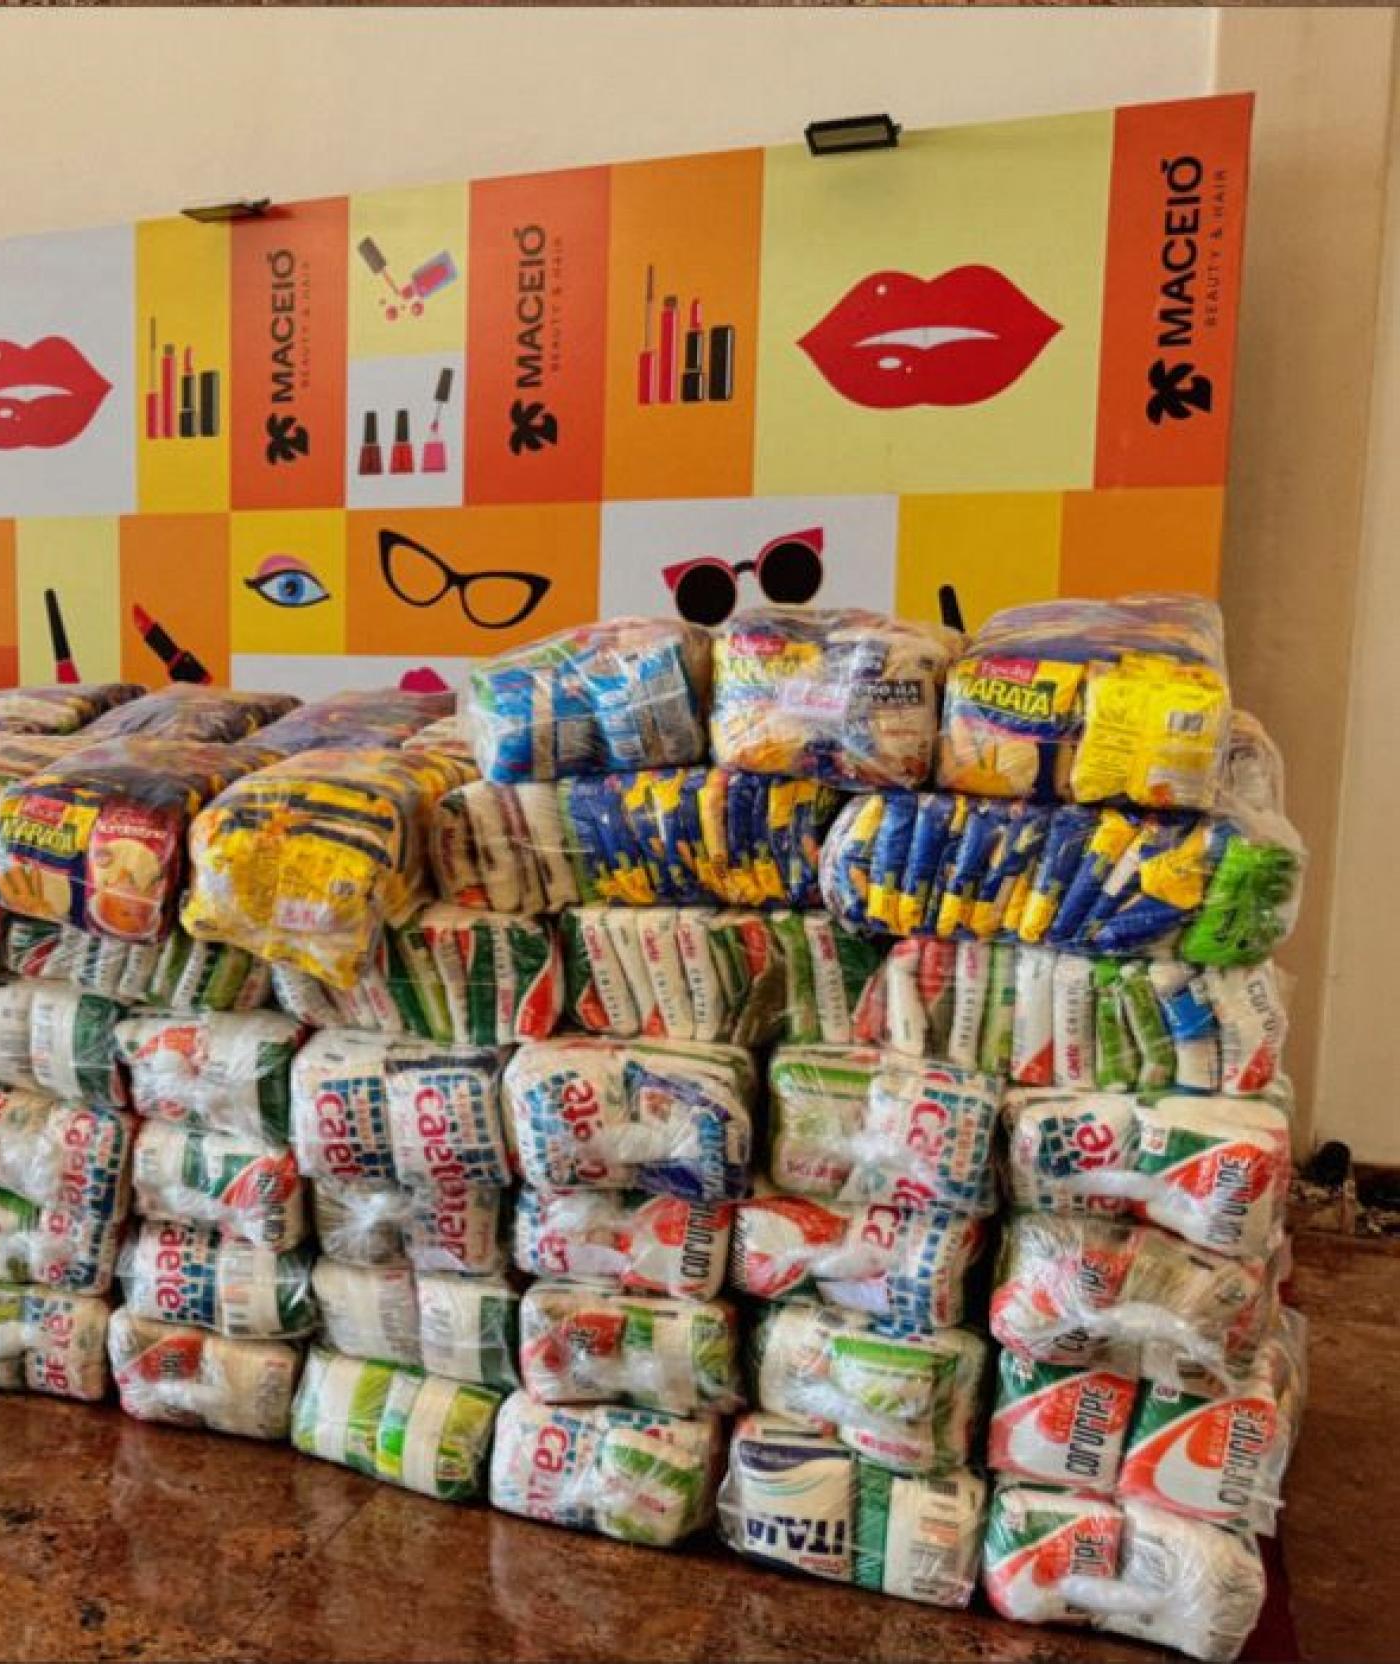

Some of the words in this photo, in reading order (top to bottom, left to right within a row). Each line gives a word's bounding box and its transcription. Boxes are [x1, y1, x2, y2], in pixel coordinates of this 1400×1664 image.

[266, 249, 295, 404] MACEIÓ
[513, 225, 546, 388] MACEIÓ
[1158, 156, 1203, 347] MACEIÓ
[1204, 251, 1220, 327] BEAUTY
[1213, 169, 1227, 218] HAIR
